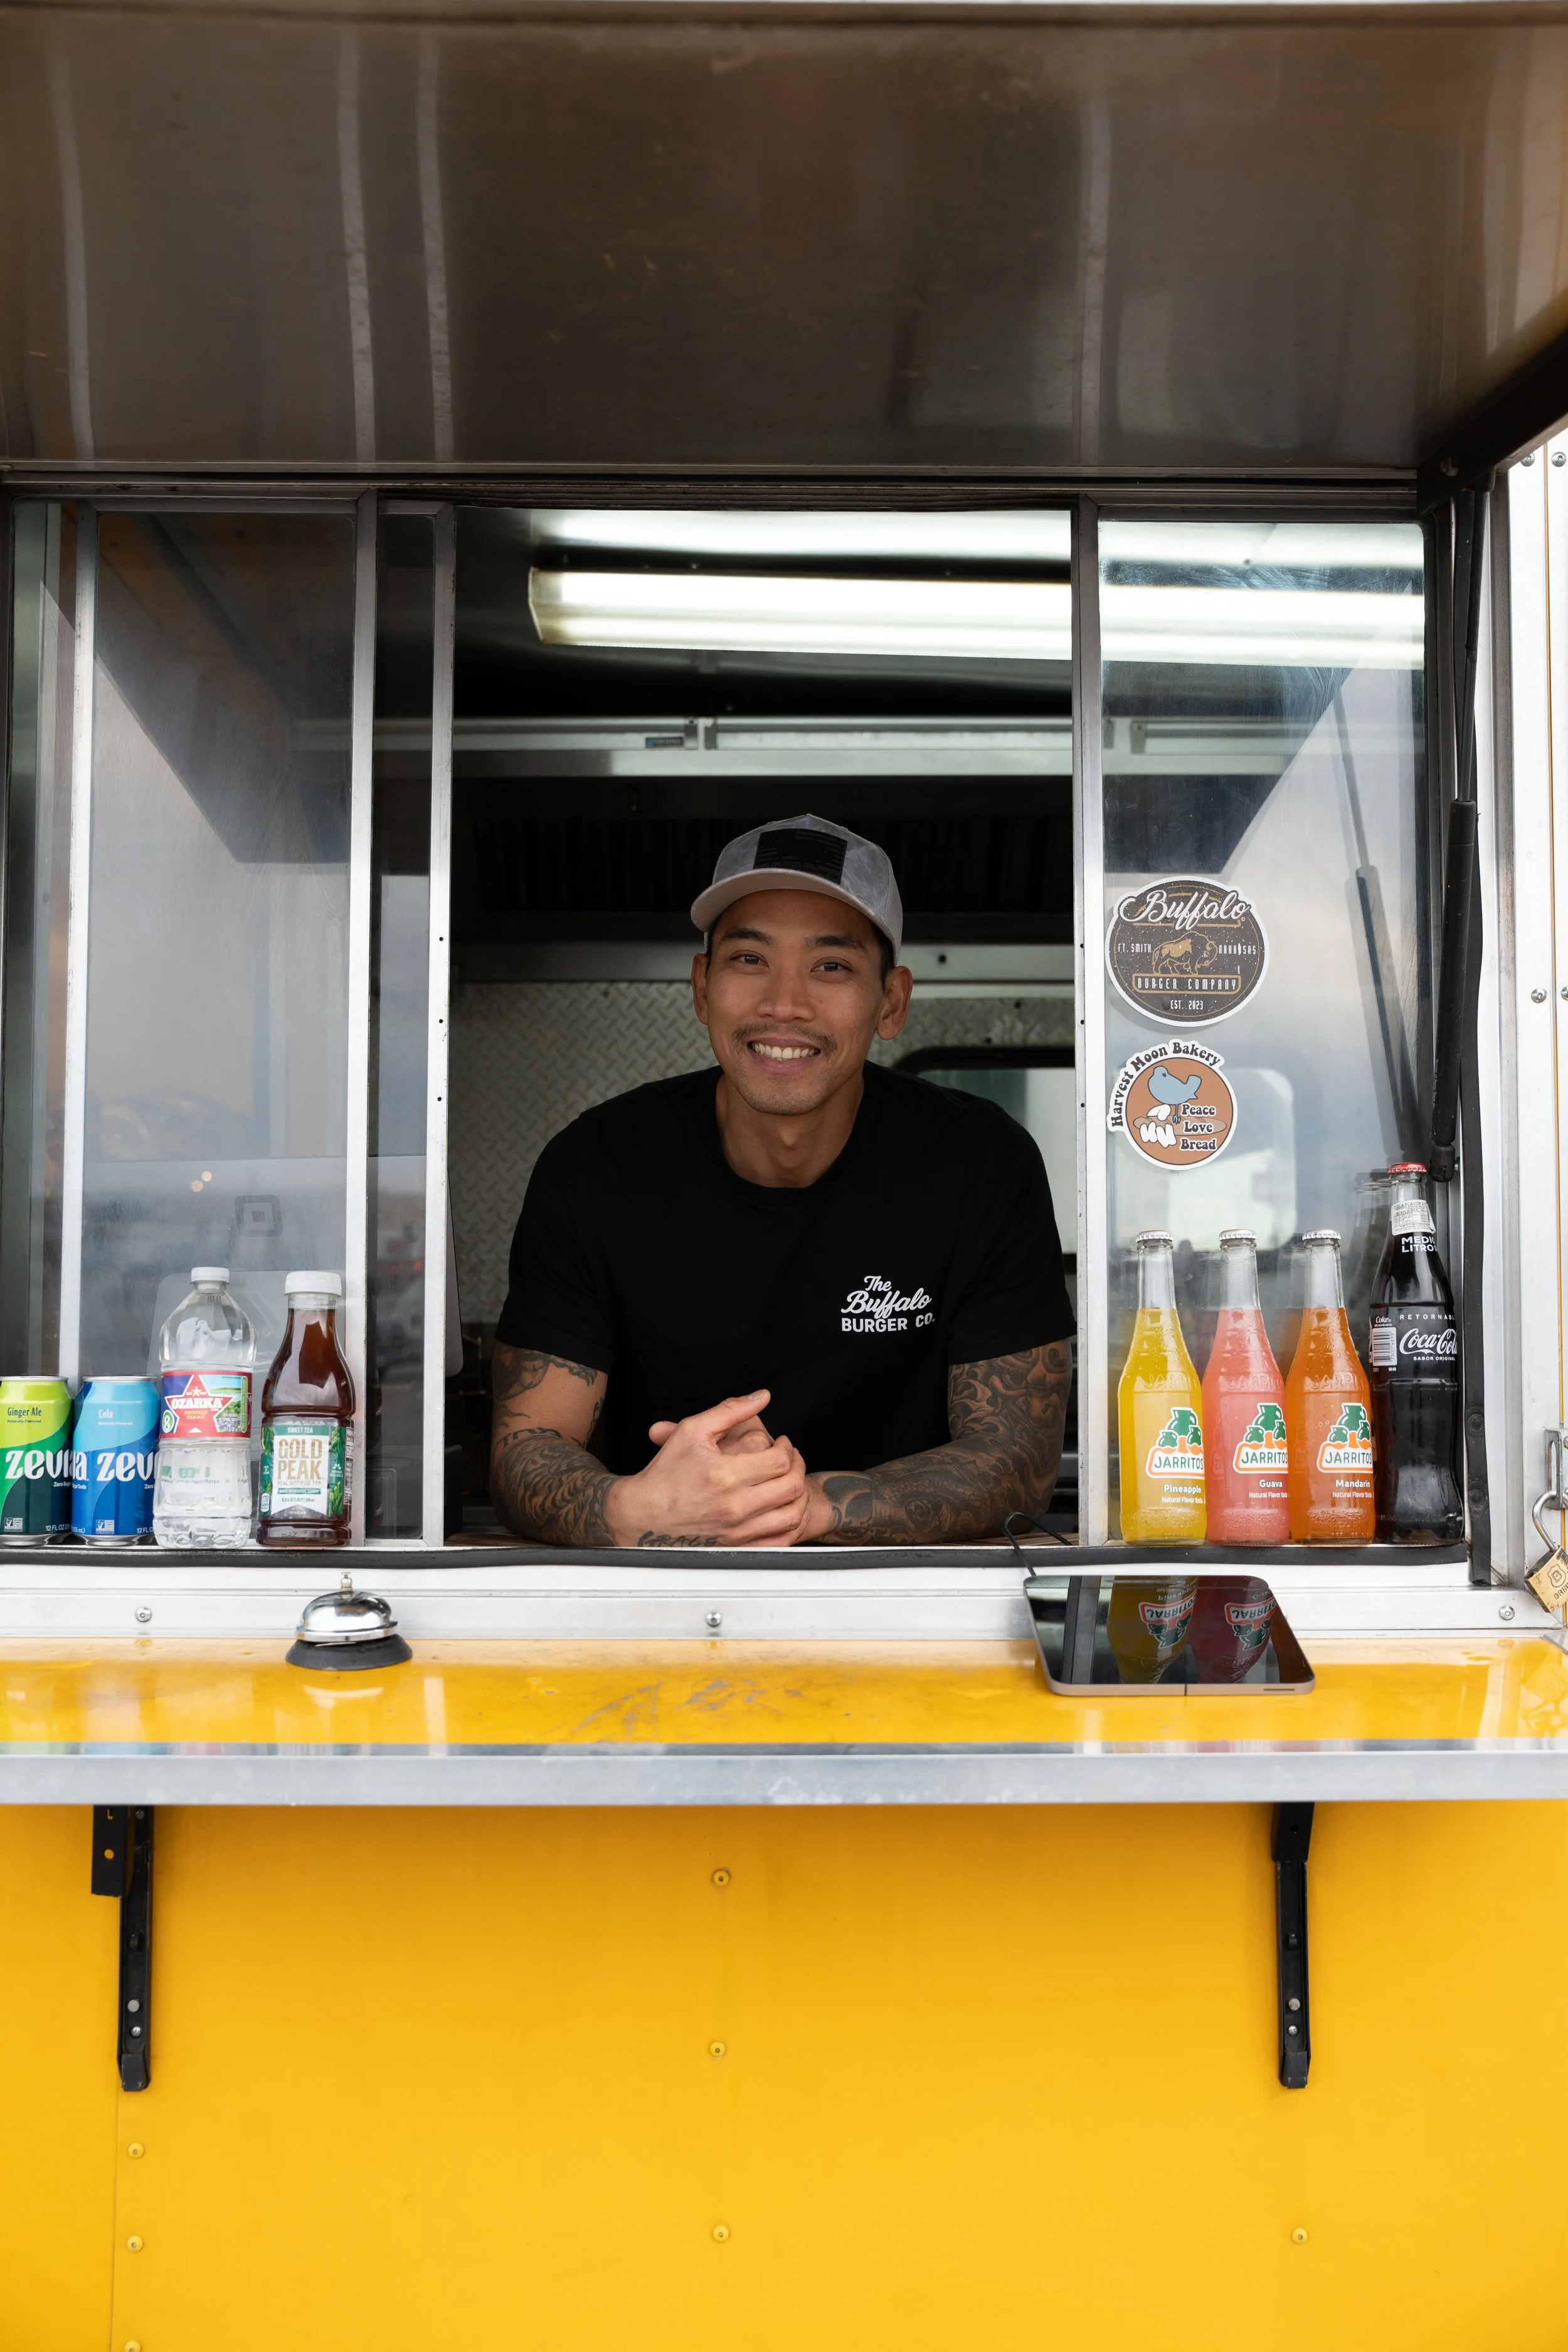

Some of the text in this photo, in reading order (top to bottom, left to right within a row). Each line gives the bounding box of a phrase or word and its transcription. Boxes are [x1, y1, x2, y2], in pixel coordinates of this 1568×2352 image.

[1120, 891, 1251, 930] Buffalo
[1131, 943, 1152, 953] SMITH
[1138, 978, 1237, 991] BURGER COMPANY
[1170, 1000, 1184, 1009] EST.
[1111, 1042, 1221, 1127] Harvest Moon Bakery
[1182, 1104, 1215, 1115] Peace
[1184, 1121, 1212, 1133] Love
[1180, 1138, 1216, 1150] Bread
[864, 1275, 892, 1292] The
[840, 1287, 932, 1319] Buffalo
[841, 1312, 935, 1333] BURGER CO.
[171, 1398, 223, 1409] OZARKA
[8, 1407, 42, 1418] Ginger Ale
[98, 1409, 114, 1419] Cola
[278, 1438, 323, 1459] GOLD
[1154, 1456, 1204, 1470] JARRITOS
[1325, 1451, 1372, 1465] JARRITOS
[278, 1459, 322, 1480] PEAK
[1163, 1484, 1202, 1495] Pineapple
[1259, 1479, 1283, 1488] Guava
[1335, 1479, 1370, 1488] Mandarin
